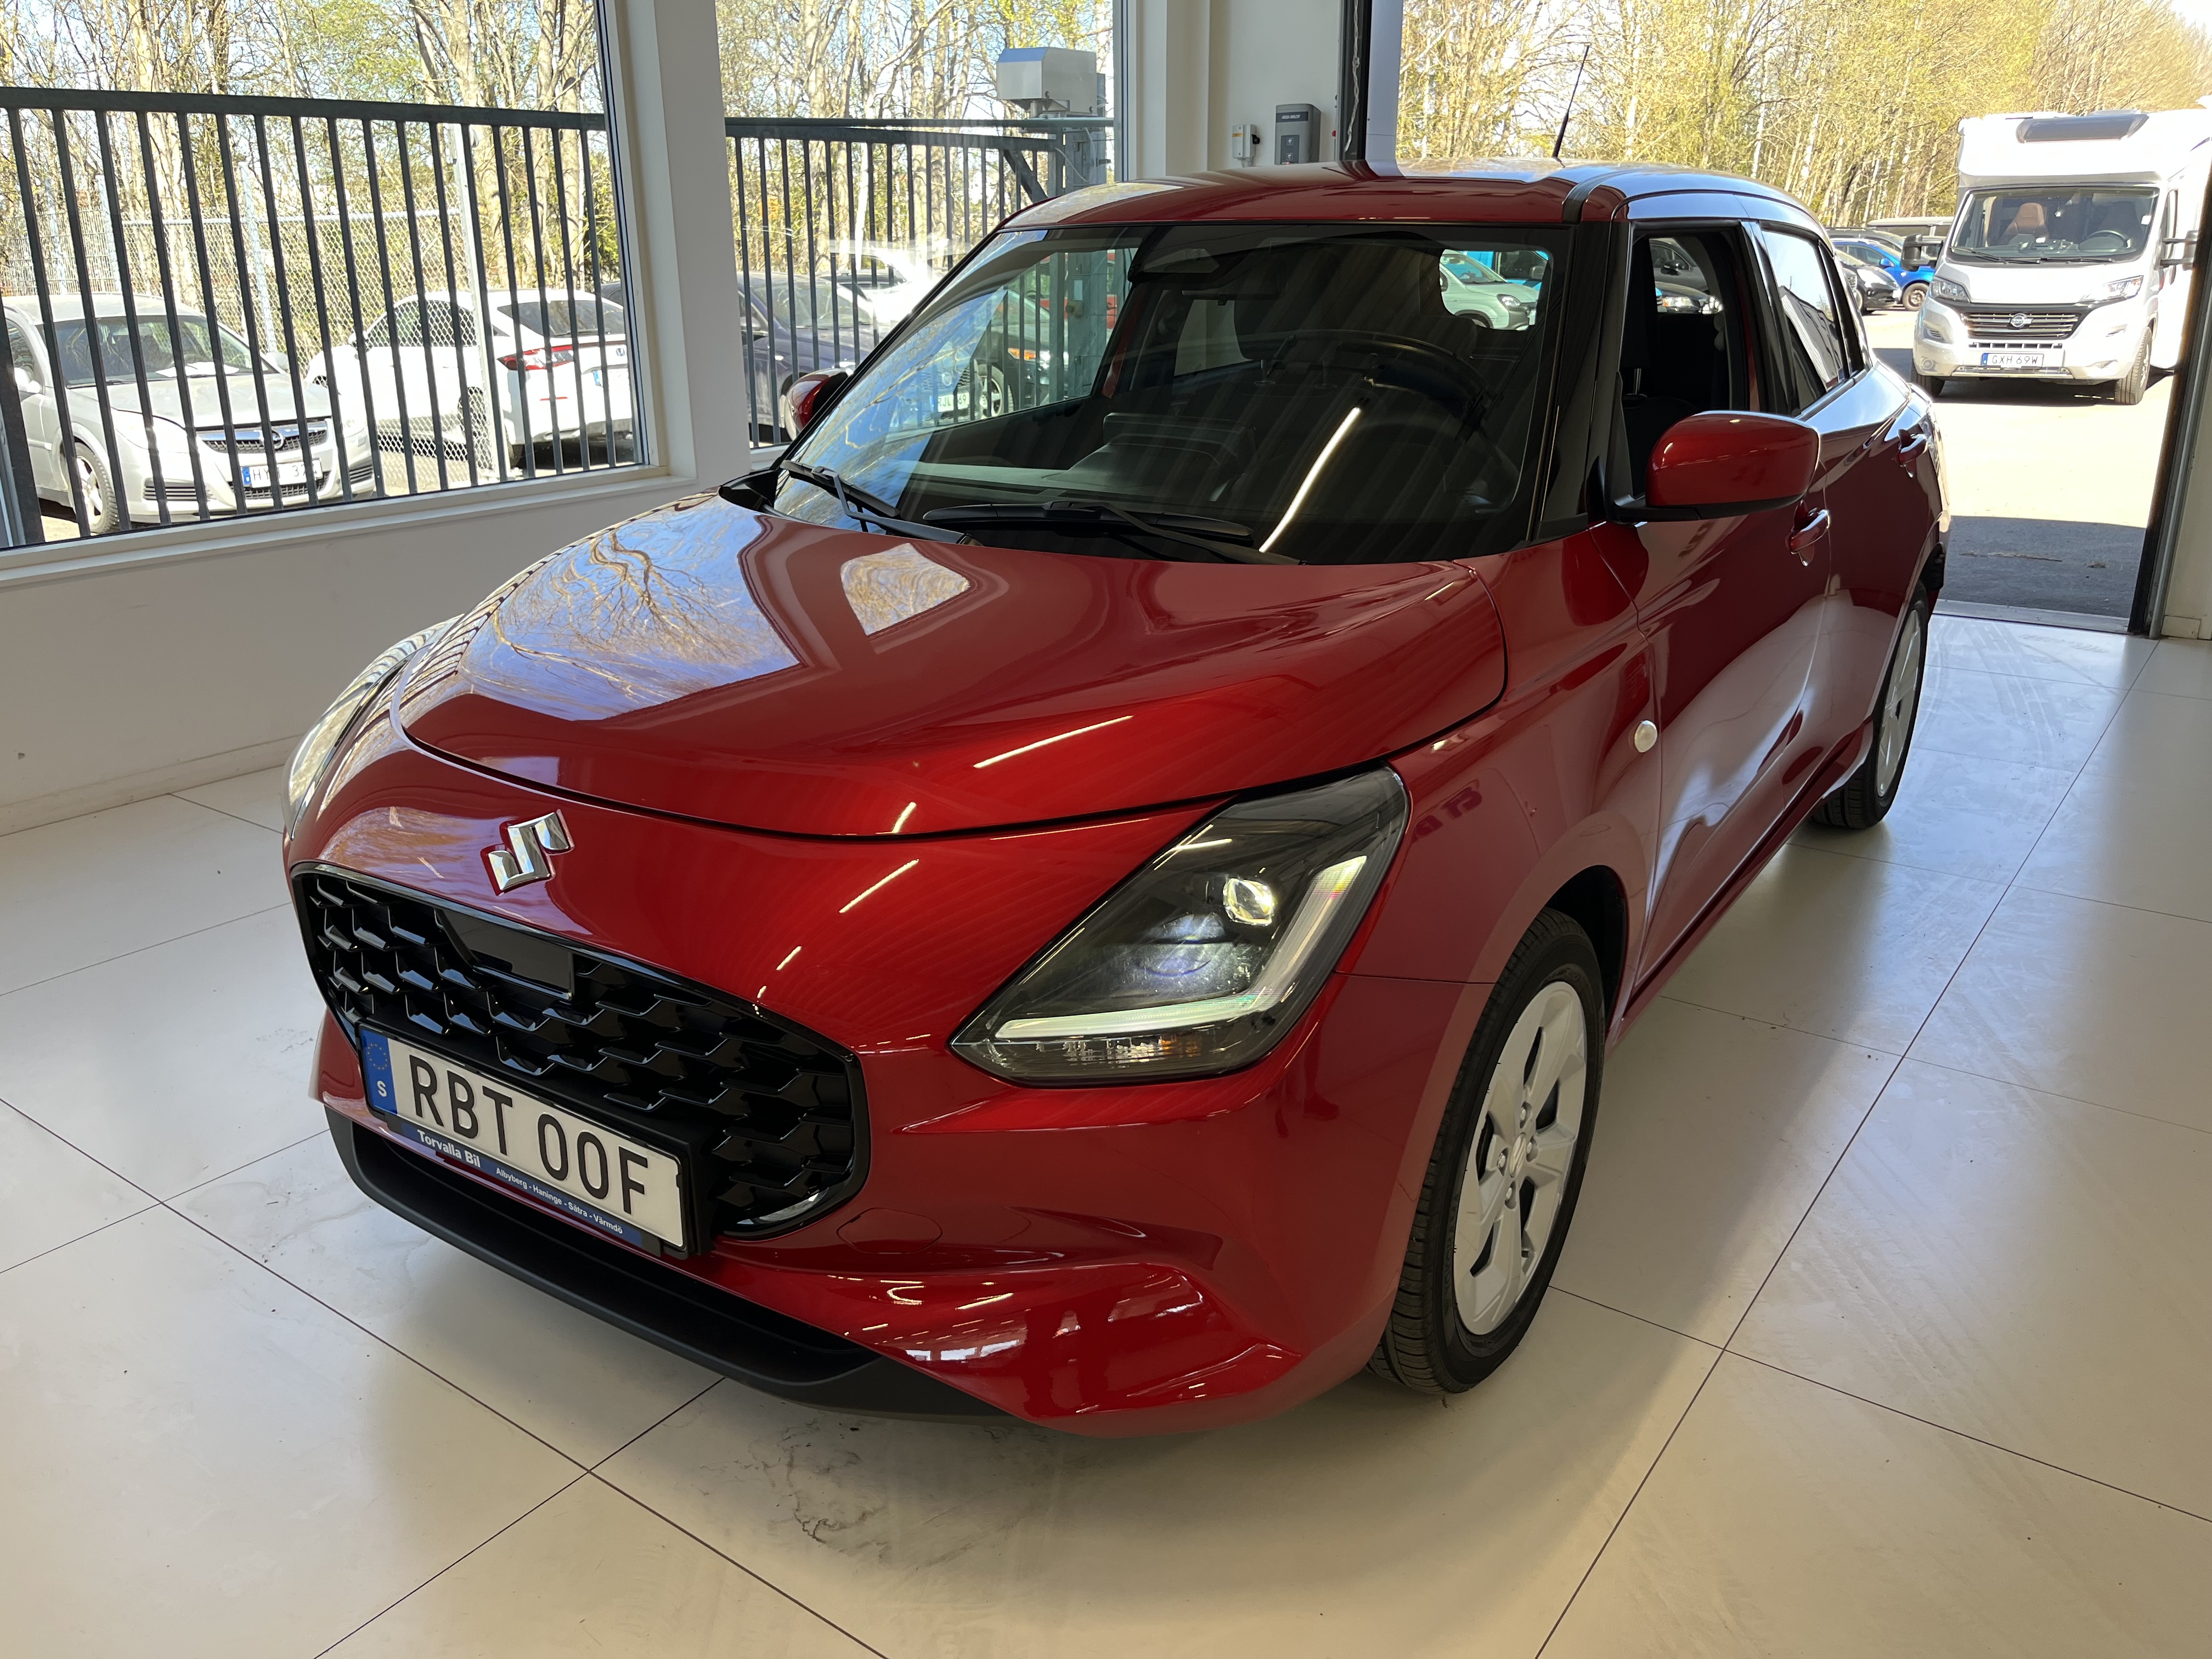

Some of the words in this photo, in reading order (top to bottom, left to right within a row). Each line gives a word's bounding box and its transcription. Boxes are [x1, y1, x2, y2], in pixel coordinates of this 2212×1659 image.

[1992, 355, 2013, 364] GXH
[2016, 355, 2038, 364] 69W
[938, 396, 951, 407] RJL
[957, 394, 966, 405] 69
[377, 1080, 387, 1097] S
[409, 1054, 512, 1156] RBT
[417, 1129, 462, 1159] Torvalla
[464, 1150, 481, 1168] Bil
[496, 1167, 528, 1190] Albyberg
[533, 1184, 562, 1205] Haninge
[568, 1201, 588, 1217] Sätra
[593, 1214, 623, 1234] Värmdö
